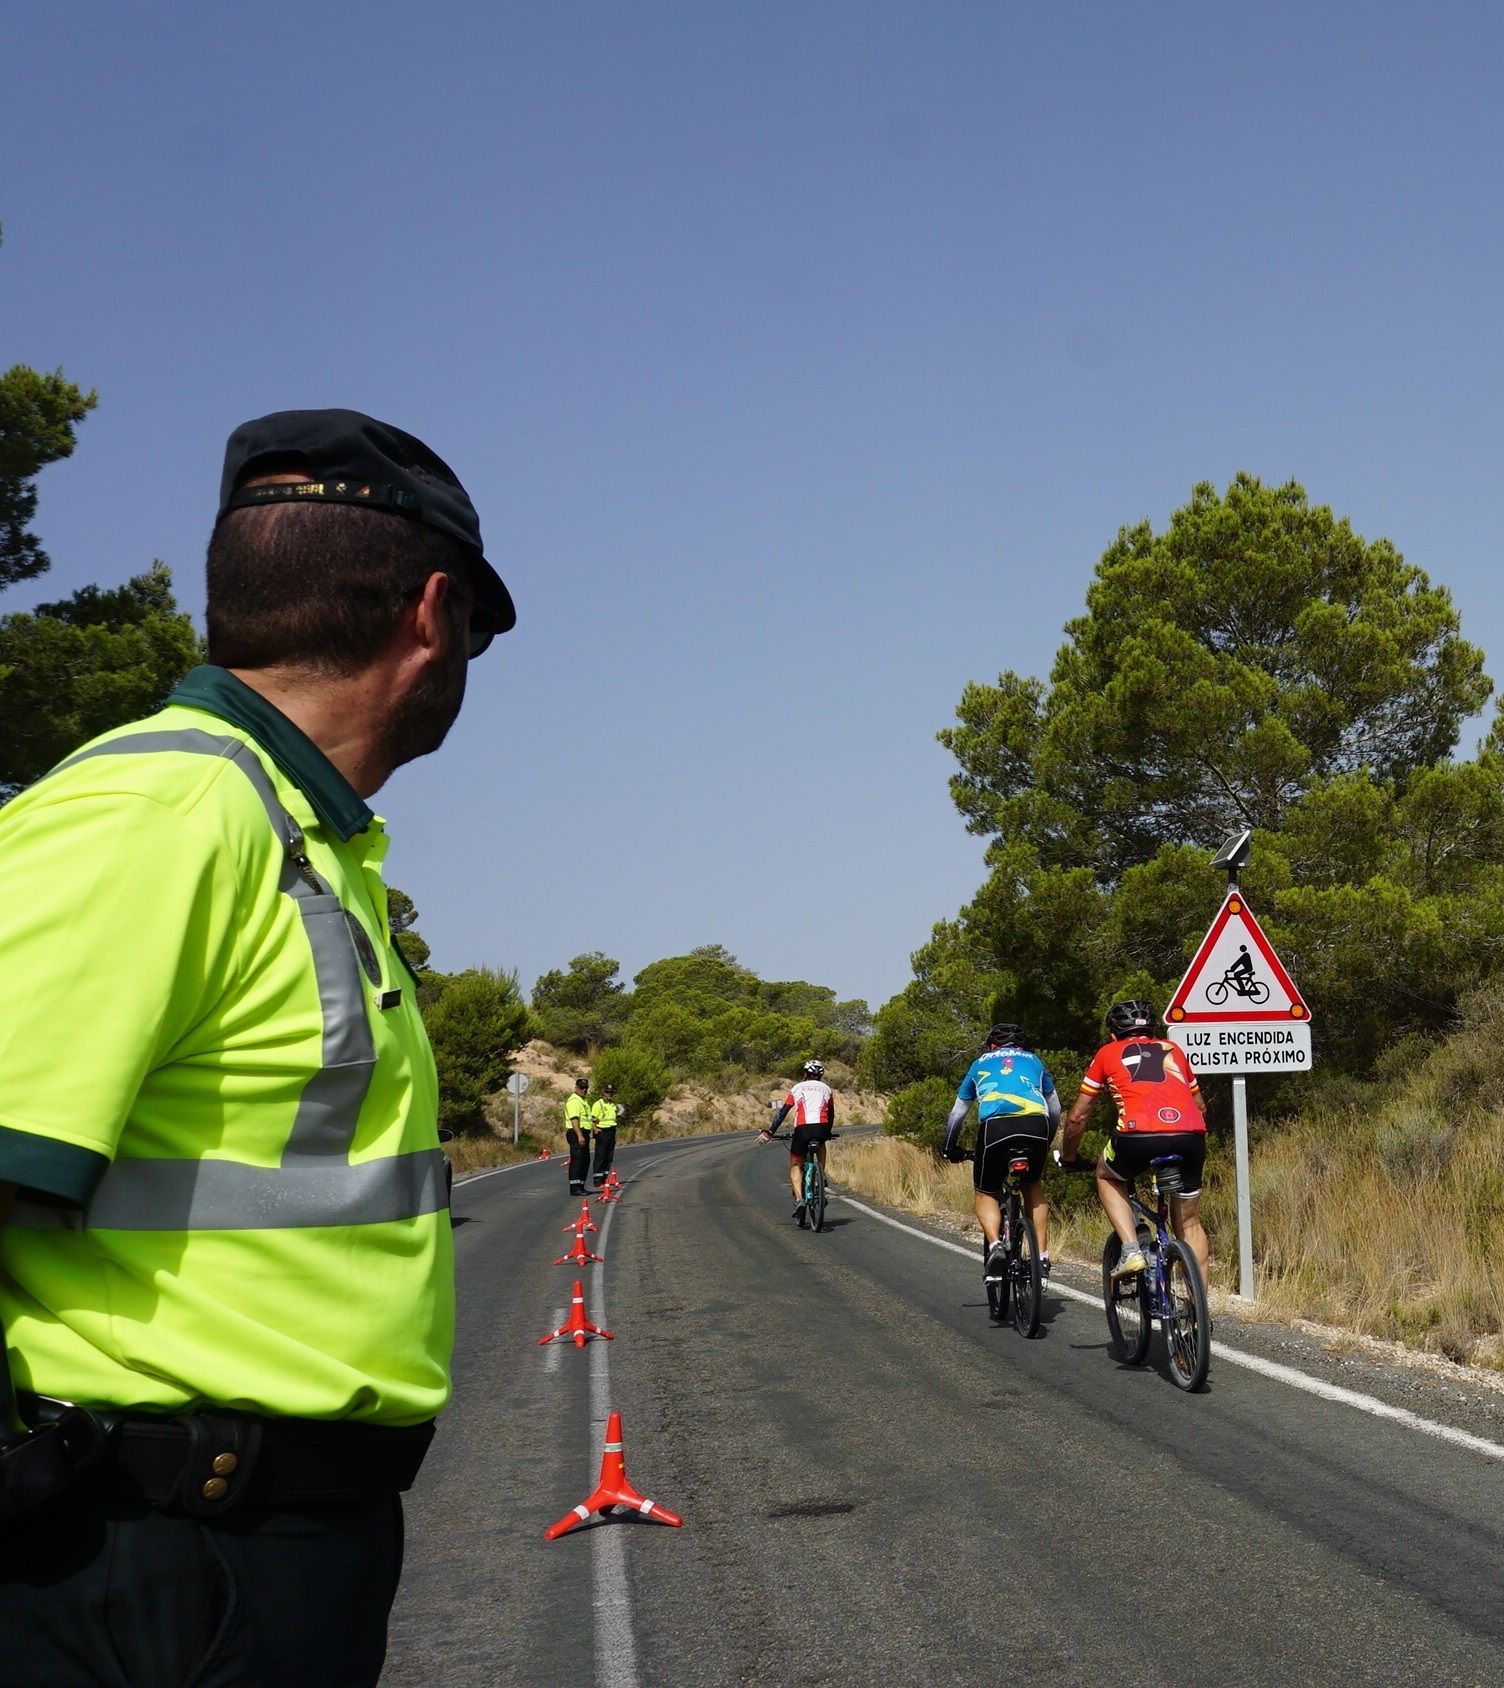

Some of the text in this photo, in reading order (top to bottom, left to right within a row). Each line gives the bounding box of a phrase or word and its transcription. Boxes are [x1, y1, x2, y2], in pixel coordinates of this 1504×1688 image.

[1186, 1031, 1294, 1046] LUZ ENCENDIDA
[1187, 1048, 1306, 1066] ICLISTA PRÓXIMO
